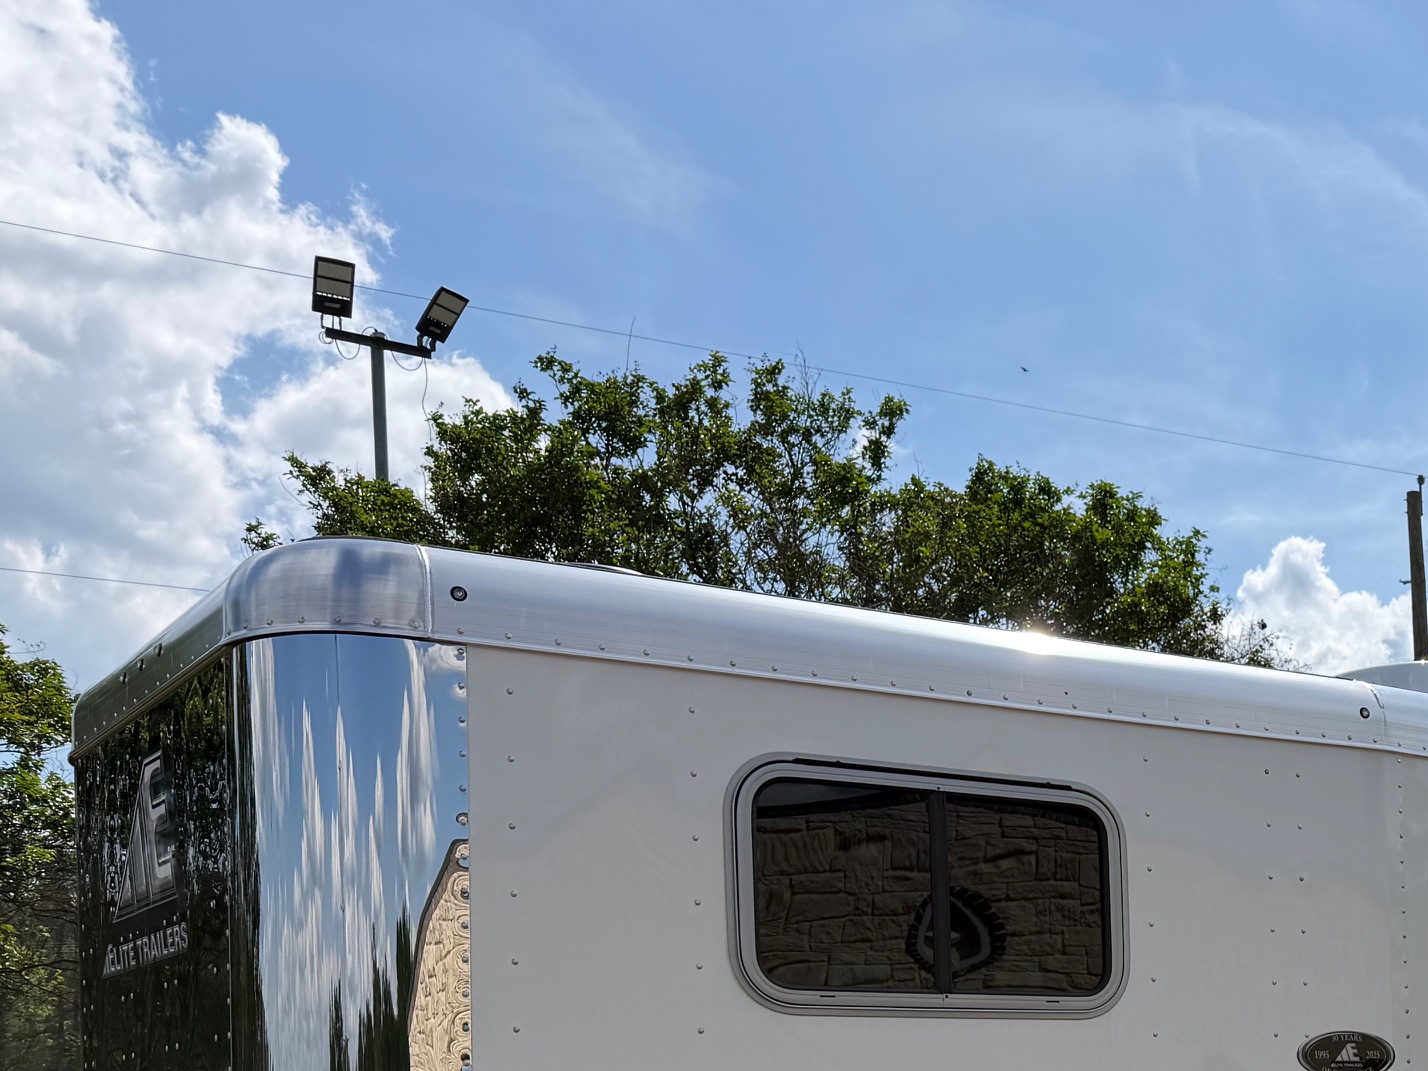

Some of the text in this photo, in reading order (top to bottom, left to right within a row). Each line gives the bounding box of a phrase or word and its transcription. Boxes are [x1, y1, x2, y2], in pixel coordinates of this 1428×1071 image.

[102, 921, 189, 978] ELITE TRAILERS
[1340, 1034, 1362, 1042] YEARS
[1314, 1050, 1330, 1059] 1995
[1366, 1050, 1380, 1059] 2025
